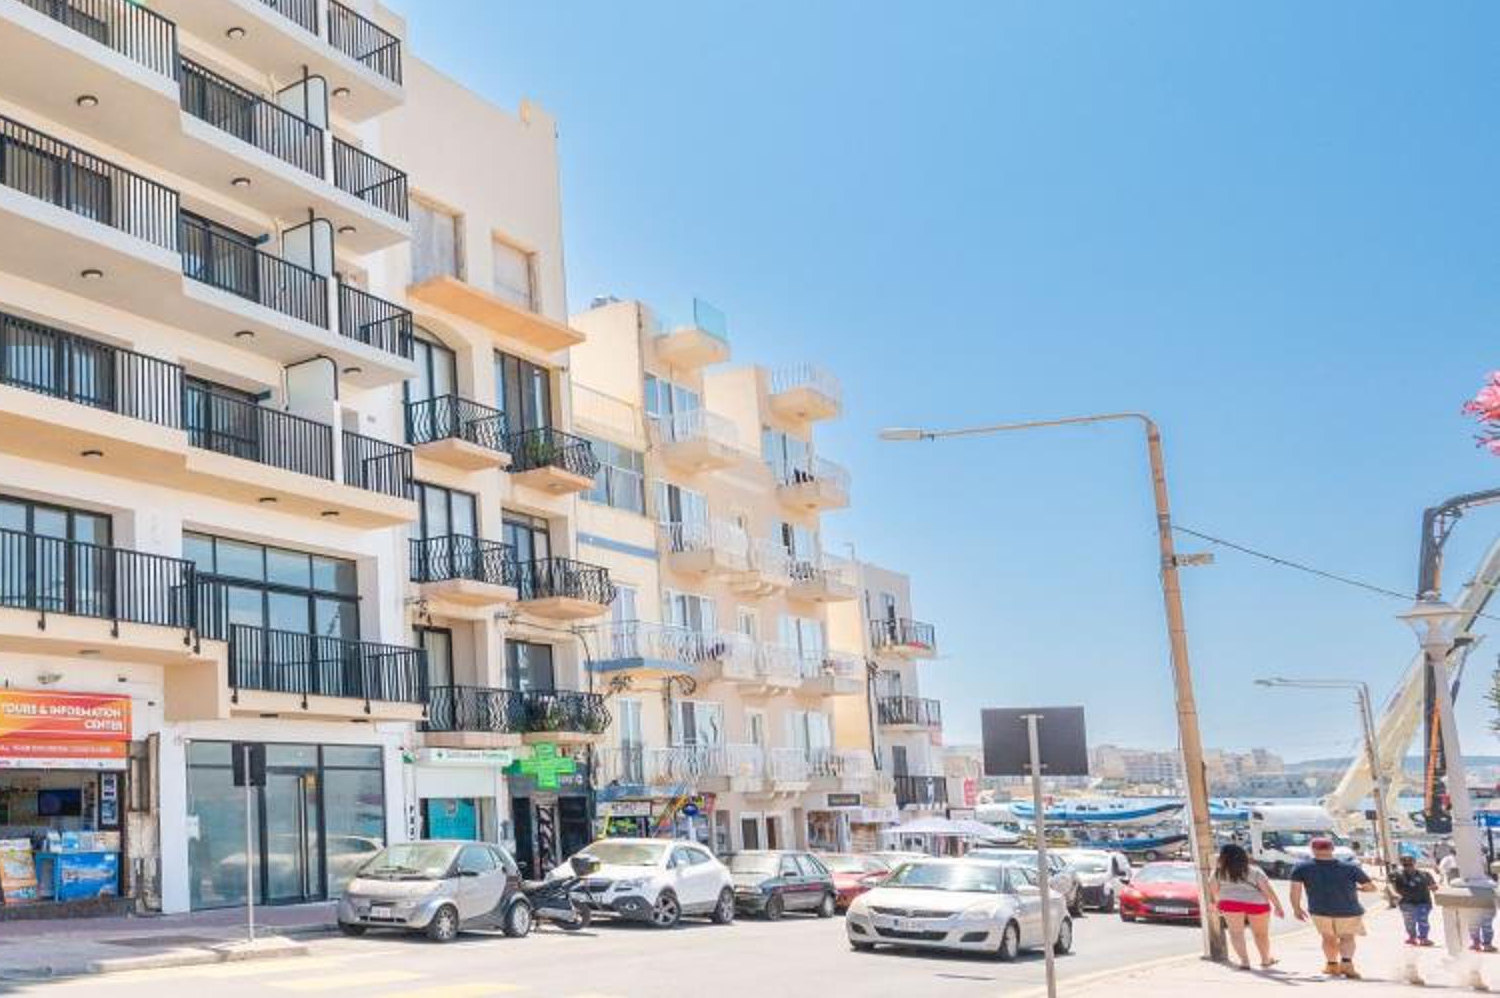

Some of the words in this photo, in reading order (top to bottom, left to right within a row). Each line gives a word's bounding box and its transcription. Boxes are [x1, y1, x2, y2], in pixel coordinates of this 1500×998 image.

[39, 705, 49, 715] &
[50, 705, 121, 718] INFORMATION
[84, 720, 123, 731] CENTER
